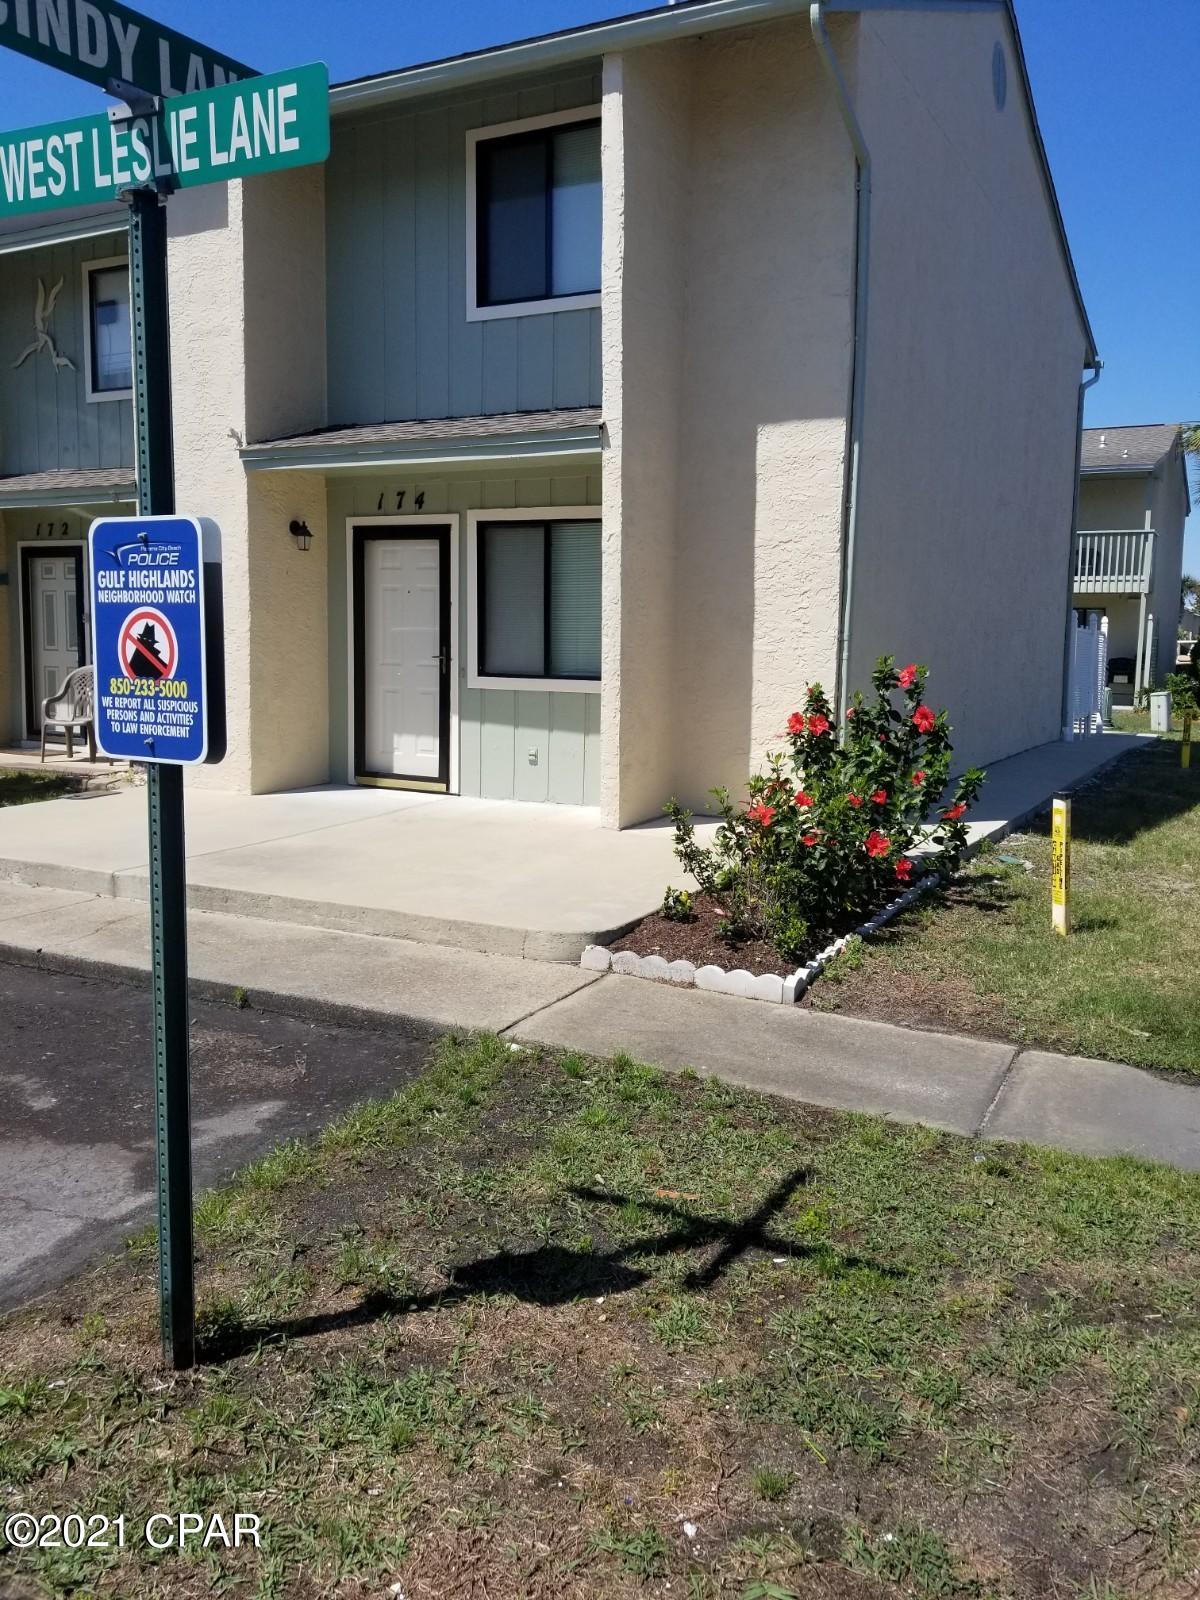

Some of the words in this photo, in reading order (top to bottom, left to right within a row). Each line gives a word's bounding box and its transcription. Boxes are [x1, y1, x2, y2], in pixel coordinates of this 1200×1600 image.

[0, 0, 140, 82] INDY
[159, 38, 251, 97] LA
[0, 131, 84, 203] WEST
[92, 106, 199, 188] LESLIE
[208, 83, 300, 166] LANE
[377, 491, 425, 510] 174
[36, 522, 69, 537] 172
[127, 552, 180, 566] POLICE
[98, 570, 126, 589] GULF
[128, 570, 196, 589] HIGHLANDS
[98, 589, 165, 604] NEIGHBORHOOD
[166, 589, 196, 604] WATCH
[110, 677, 187, 699] 850-233-5000
[102, 696, 113, 708] WE
[115, 697, 141, 710] REPORT
[143, 699, 156, 711] ALL
[158, 700, 199, 714] SUSPICIOUS
[106, 709, 138, 722] PERSONS
[140, 711, 156, 722] AND
[157, 713, 194, 726] ACTIVITIES
[111, 721, 120, 733] TO
[122, 722, 138, 734] LAW
[140, 724, 190, 738] ENFORCEMENT
